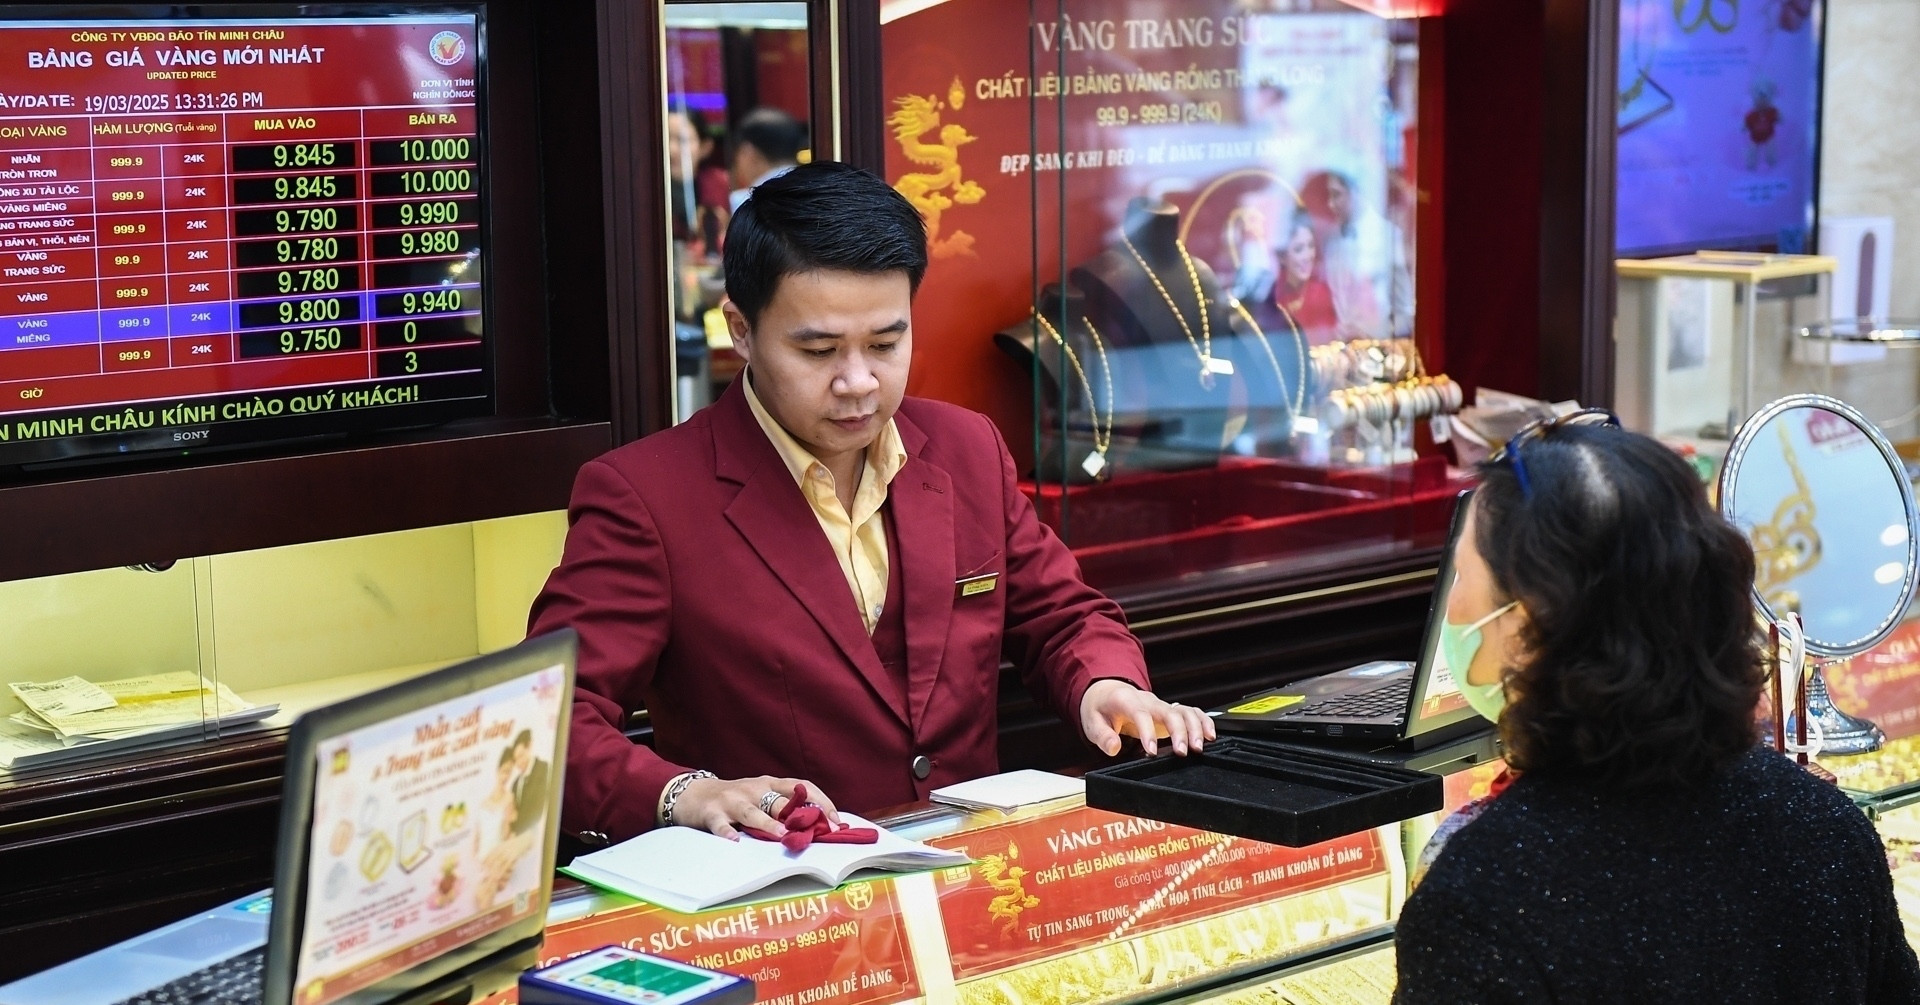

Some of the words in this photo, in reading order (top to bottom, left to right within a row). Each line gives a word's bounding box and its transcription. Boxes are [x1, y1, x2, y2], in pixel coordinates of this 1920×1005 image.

[71, 31, 108, 42] CÔNG
[111, 32, 126, 42] TY
[130, 32, 165, 42] VBĐQ
[197, 30, 216, 40] TÍN
[220, 31, 249, 40] MINH
[252, 30, 285, 40] CHÂU
[1036, 13, 1116, 52] VÀNG
[1124, 16, 1214, 50] TRANG
[28, 48, 93, 68] BẢNG
[106, 47, 145, 67] GIÁ
[155, 46, 217, 66] VÀNG
[223, 45, 263, 65] MỚI
[269, 45, 325, 64] NHẤT
[146, 72, 188, 80] UPDATED
[190, 71, 217, 79] PRICE
[421, 79, 440, 87] ĐƠN
[454, 78, 474, 86] TÍNH
[975, 69, 1025, 100] CHẤT
[1028, 71, 1070, 100] LIỆU
[1073, 66, 1122, 95] BẰNG
[1125, 67, 1172, 92] VÀNG
[85, 94, 169, 114] 19/03/2025
[175, 92, 238, 110] 13:31:26
[242, 92, 263, 107] PM
[409, 113, 435, 125] BÁN
[439, 114, 457, 124] RA
[1096, 106, 1129, 127] 99.9
[1140, 103, 1180, 124] 999.9
[1183, 101, 1222, 125] (24K)
[93, 123, 122, 135] HÀM
[125, 122, 173, 136] LƯỢNG
[196, 123, 217, 133] vàng)
[254, 119, 284, 130] MUA
[287, 117, 316, 129] VÀO
[0, 127, 24, 139] OẠI
[28, 124, 67, 136] VÀNG
[274, 143, 335, 167] 9.845
[400, 138, 469, 161] 10.000
[110, 157, 143, 166] 999.9
[184, 154, 205, 163] 24K
[1000, 153, 1030, 177] ĐẸP
[1035, 152, 1074, 171] SANG
[1077, 150, 1103, 168] KHI
[28, 169, 57, 178] TRƠN
[275, 175, 336, 199] 9.845
[401, 169, 470, 193] 10.000
[22, 187, 37, 196] XU
[40, 185, 55, 195] TÀI
[58, 184, 80, 195] LỘC
[112, 191, 144, 201] 999.9
[185, 187, 206, 197] 24K
[0, 203, 30, 214] VÀNG
[400, 201, 459, 226] 9.990
[17, 220, 51, 229] TRANG
[53, 218, 75, 227] SỨC
[186, 220, 207, 229] 24K
[276, 208, 337, 232] 9.790
[113, 224, 146, 234] 999.9
[401, 230, 459, 255] 9.980
[17, 251, 47, 261] VÀNG
[187, 250, 209, 260] 24K
[277, 237, 338, 263] 9.780
[115, 255, 141, 265] 99.9
[4, 268, 40, 277] TRANG
[42, 265, 66, 274] SỨC
[189, 283, 210, 292] 24K
[278, 268, 339, 293] 9.780
[17, 292, 48, 303] VÀNG
[116, 288, 149, 298] 999.9
[403, 289, 461, 314] 9.940
[191, 312, 212, 322] 24K
[279, 298, 340, 323] 9.800
[17, 319, 48, 329] VÀNG
[118, 318, 151, 328] 999.9
[404, 321, 417, 343] 0
[280, 327, 341, 353] 9.750
[119, 350, 151, 361] 999.9
[191, 345, 213, 355] 24K
[405, 351, 418, 373] 3
[20, 388, 44, 399] GIỜ
[17, 417, 83, 440] MINH
[90, 408, 155, 432] CHÂU
[162, 403, 216, 426] KÍNH
[222, 396, 284, 420] CHÀO
[289, 389, 336, 414] QUÝ
[342, 384, 420, 409] KHÁCH!
[173, 430, 210, 442] SONY
[1046, 827, 1101, 854] VÀNG
[1103, 817, 1166, 842] TRANG
[1035, 863, 1066, 885] CHẤT
[1067, 858, 1093, 879] LIỆU
[1094, 850, 1126, 872] BẰNG
[1125, 844, 1159, 864] VÀNG
[1114, 874, 1129, 888] Giá
[1130, 872, 1151, 886] công
[1204, 847, 1245, 868] 5.000.000
[1027, 926, 1042, 942] TỰ
[1043, 920, 1063, 937] TIN
[1065, 914, 1093, 931] SANG
[1169, 891, 1190, 906] HOẠ
[1192, 884, 1216, 900] TÍNH
[1218, 875, 1243, 894] CÁCH
[1252, 866, 1285, 886] THANH
[1337, 846, 1363, 866] DÀNG
[650, 923, 693, 954] SỨC
[695, 906, 760, 943] NGHỆ
[686, 954, 724, 970] ĂNG
[727, 943, 763, 966] LONG
[764, 937, 789, 956] 99.9
[796, 928, 827, 948] 999.9
[829, 920, 860, 944] (24K)
[797, 981, 839, 1003] KHOẢN
[843, 972, 858, 993] DỄ
[861, 967, 893, 989] DÀNG
